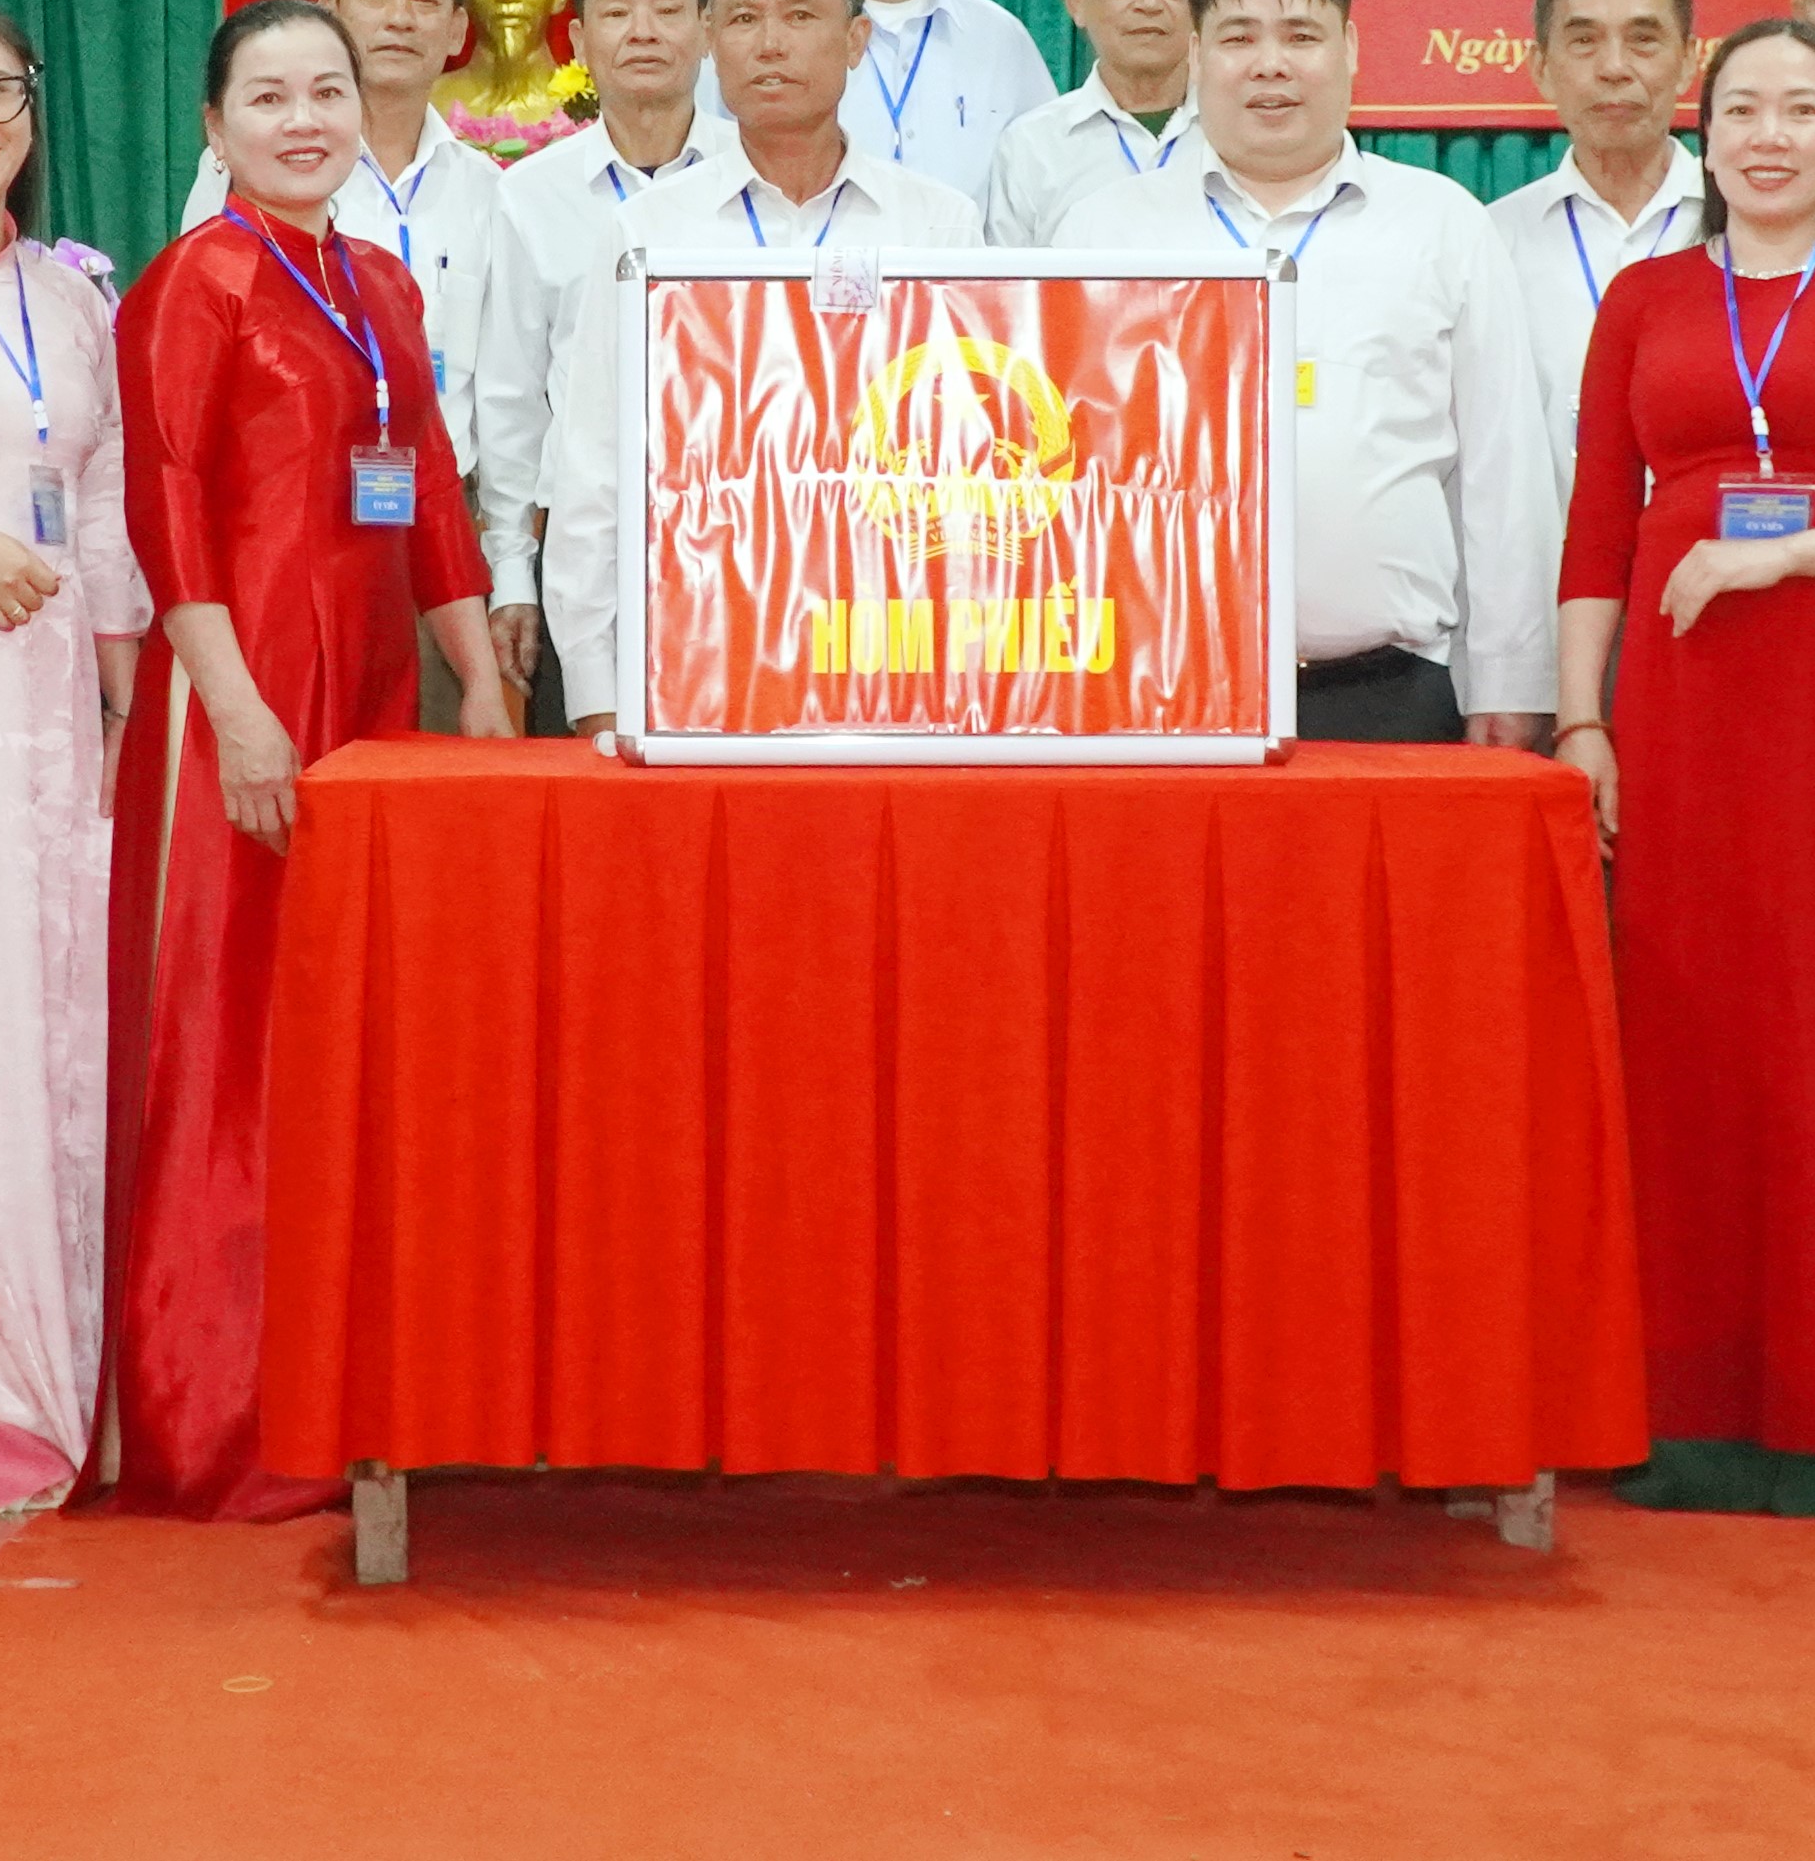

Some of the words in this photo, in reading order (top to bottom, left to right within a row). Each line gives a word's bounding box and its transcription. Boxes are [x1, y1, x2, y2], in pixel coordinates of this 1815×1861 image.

[1421, 27, 1536, 75] Ngày
[811, 583, 934, 674] HÒM
[949, 576, 1115, 674] PHIẾU
